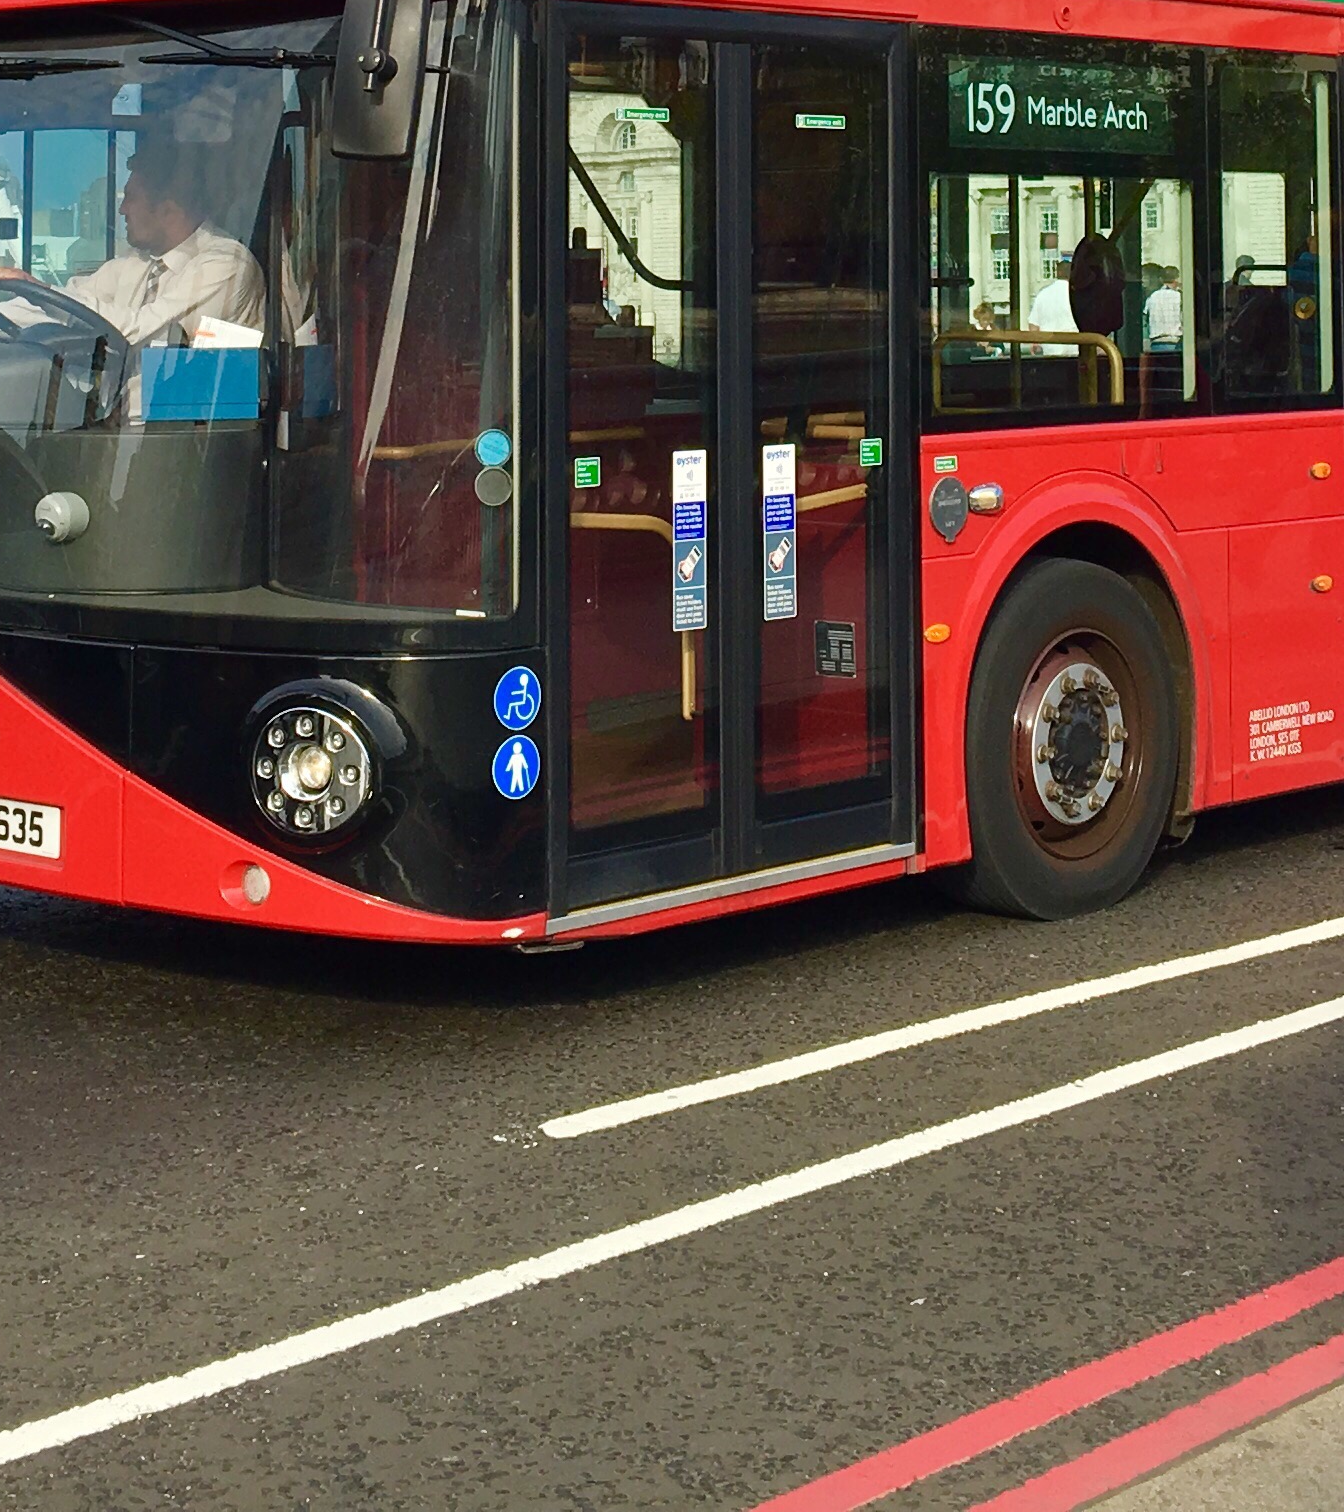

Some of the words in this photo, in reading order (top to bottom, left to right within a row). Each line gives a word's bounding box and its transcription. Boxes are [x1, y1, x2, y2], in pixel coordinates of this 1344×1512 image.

[967, 82, 1016, 134] 159
[1027, 95, 1097, 128] Marble
[1103, 100, 1148, 131] Arch
